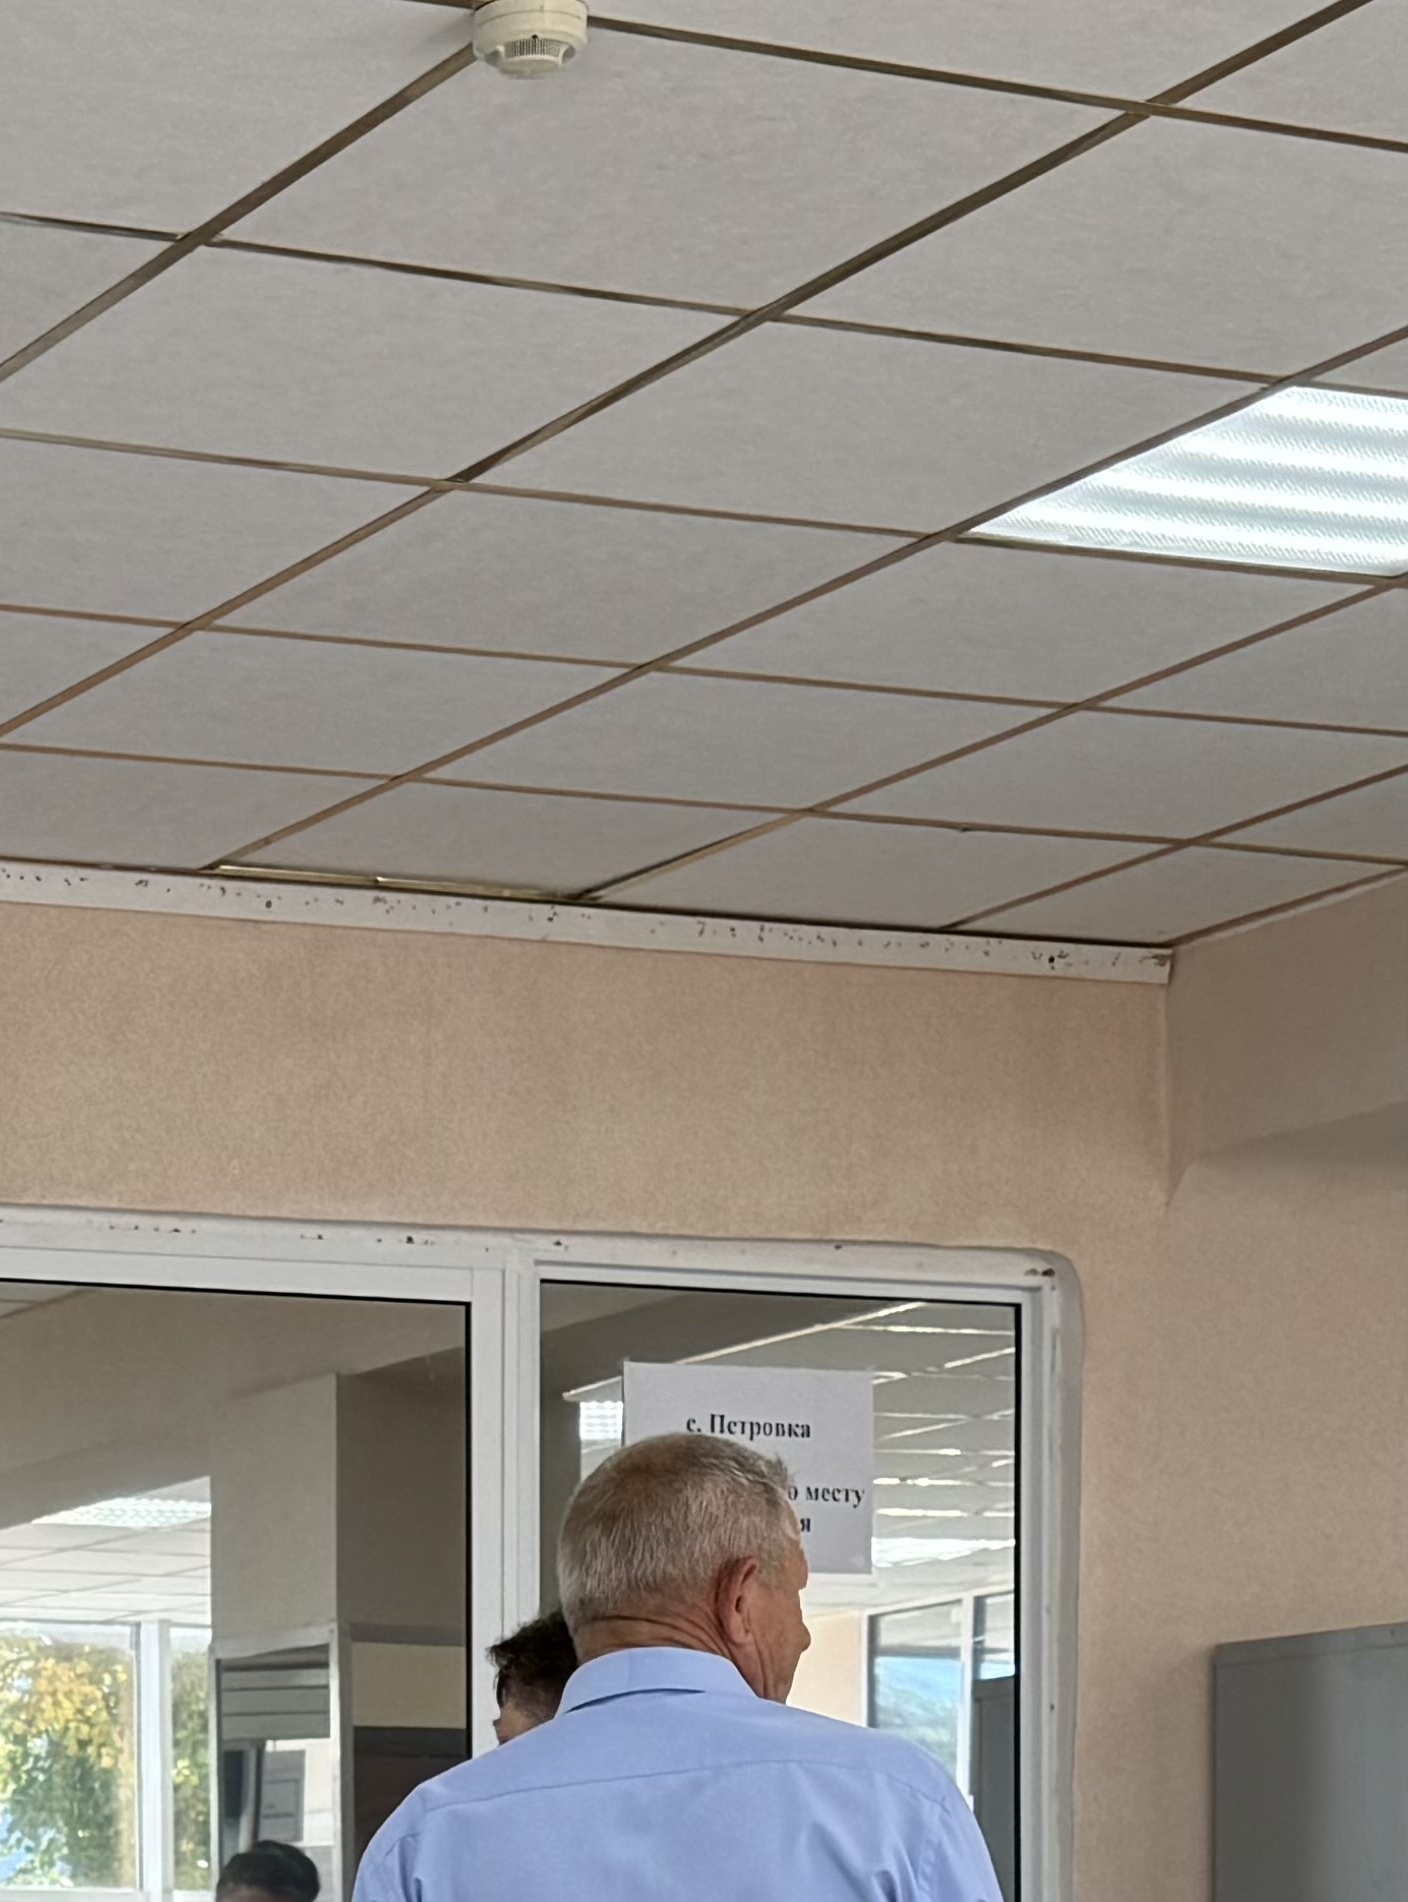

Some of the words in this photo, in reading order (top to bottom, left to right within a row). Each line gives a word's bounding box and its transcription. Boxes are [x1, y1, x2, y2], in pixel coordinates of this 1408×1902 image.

[686, 1418, 702, 1434] с.
[710, 1413, 811, 1442] Петровка
[806, 1486, 865, 1509] месту
